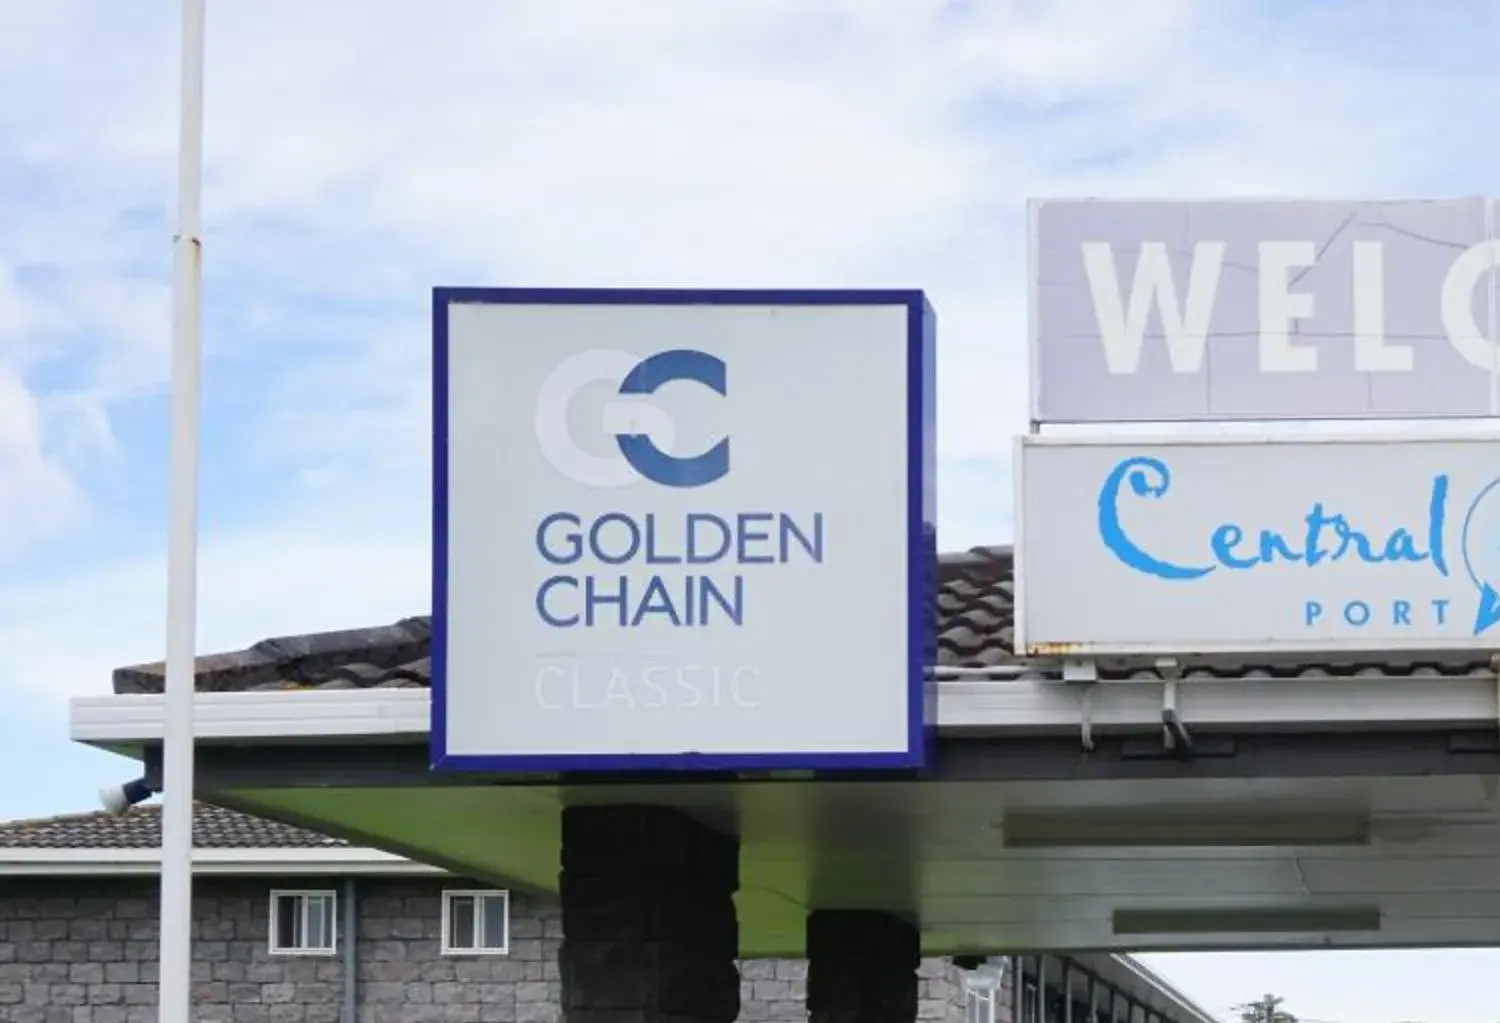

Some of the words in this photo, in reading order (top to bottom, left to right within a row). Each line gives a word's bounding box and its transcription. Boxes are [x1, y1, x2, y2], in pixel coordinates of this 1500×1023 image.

[536, 512, 824, 565] GOLDEN
[1098, 457, 1450, 580] Central
[536, 575, 744, 628] CHAIN
[1305, 599, 1452, 627] PORT
[533, 664, 764, 710] CLASSIC
